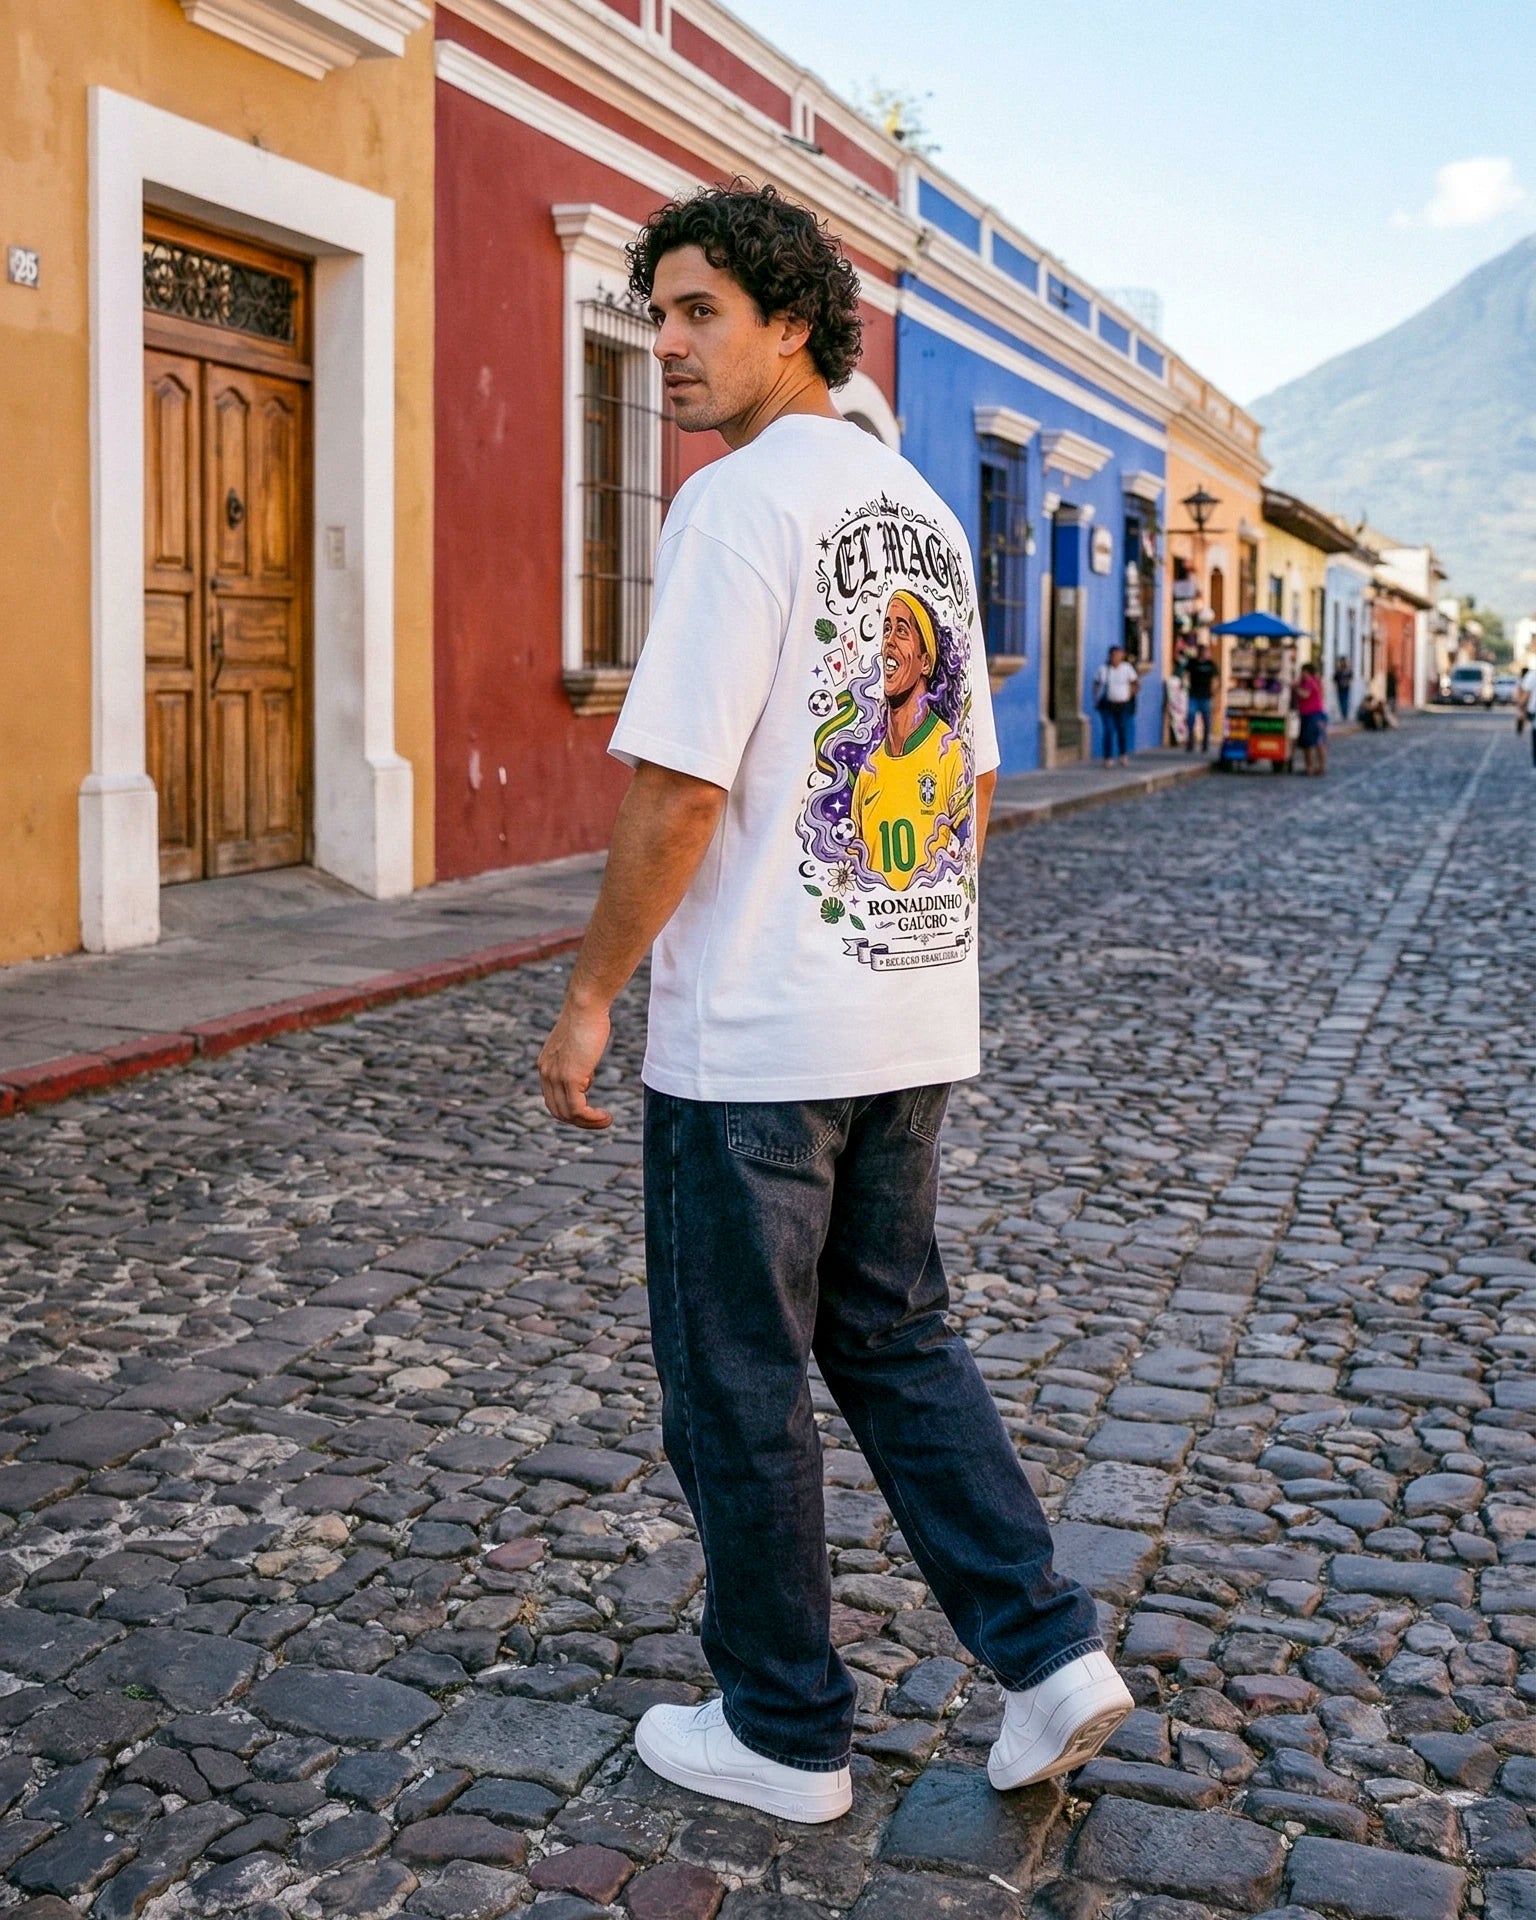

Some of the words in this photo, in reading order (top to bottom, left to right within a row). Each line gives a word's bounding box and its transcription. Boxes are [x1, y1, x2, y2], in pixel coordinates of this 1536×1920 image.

[833, 523, 878, 599] EL
[877, 521, 963, 606] MAGO
[879, 819, 916, 873] 10
[867, 894, 962, 916] RONALDINHO
